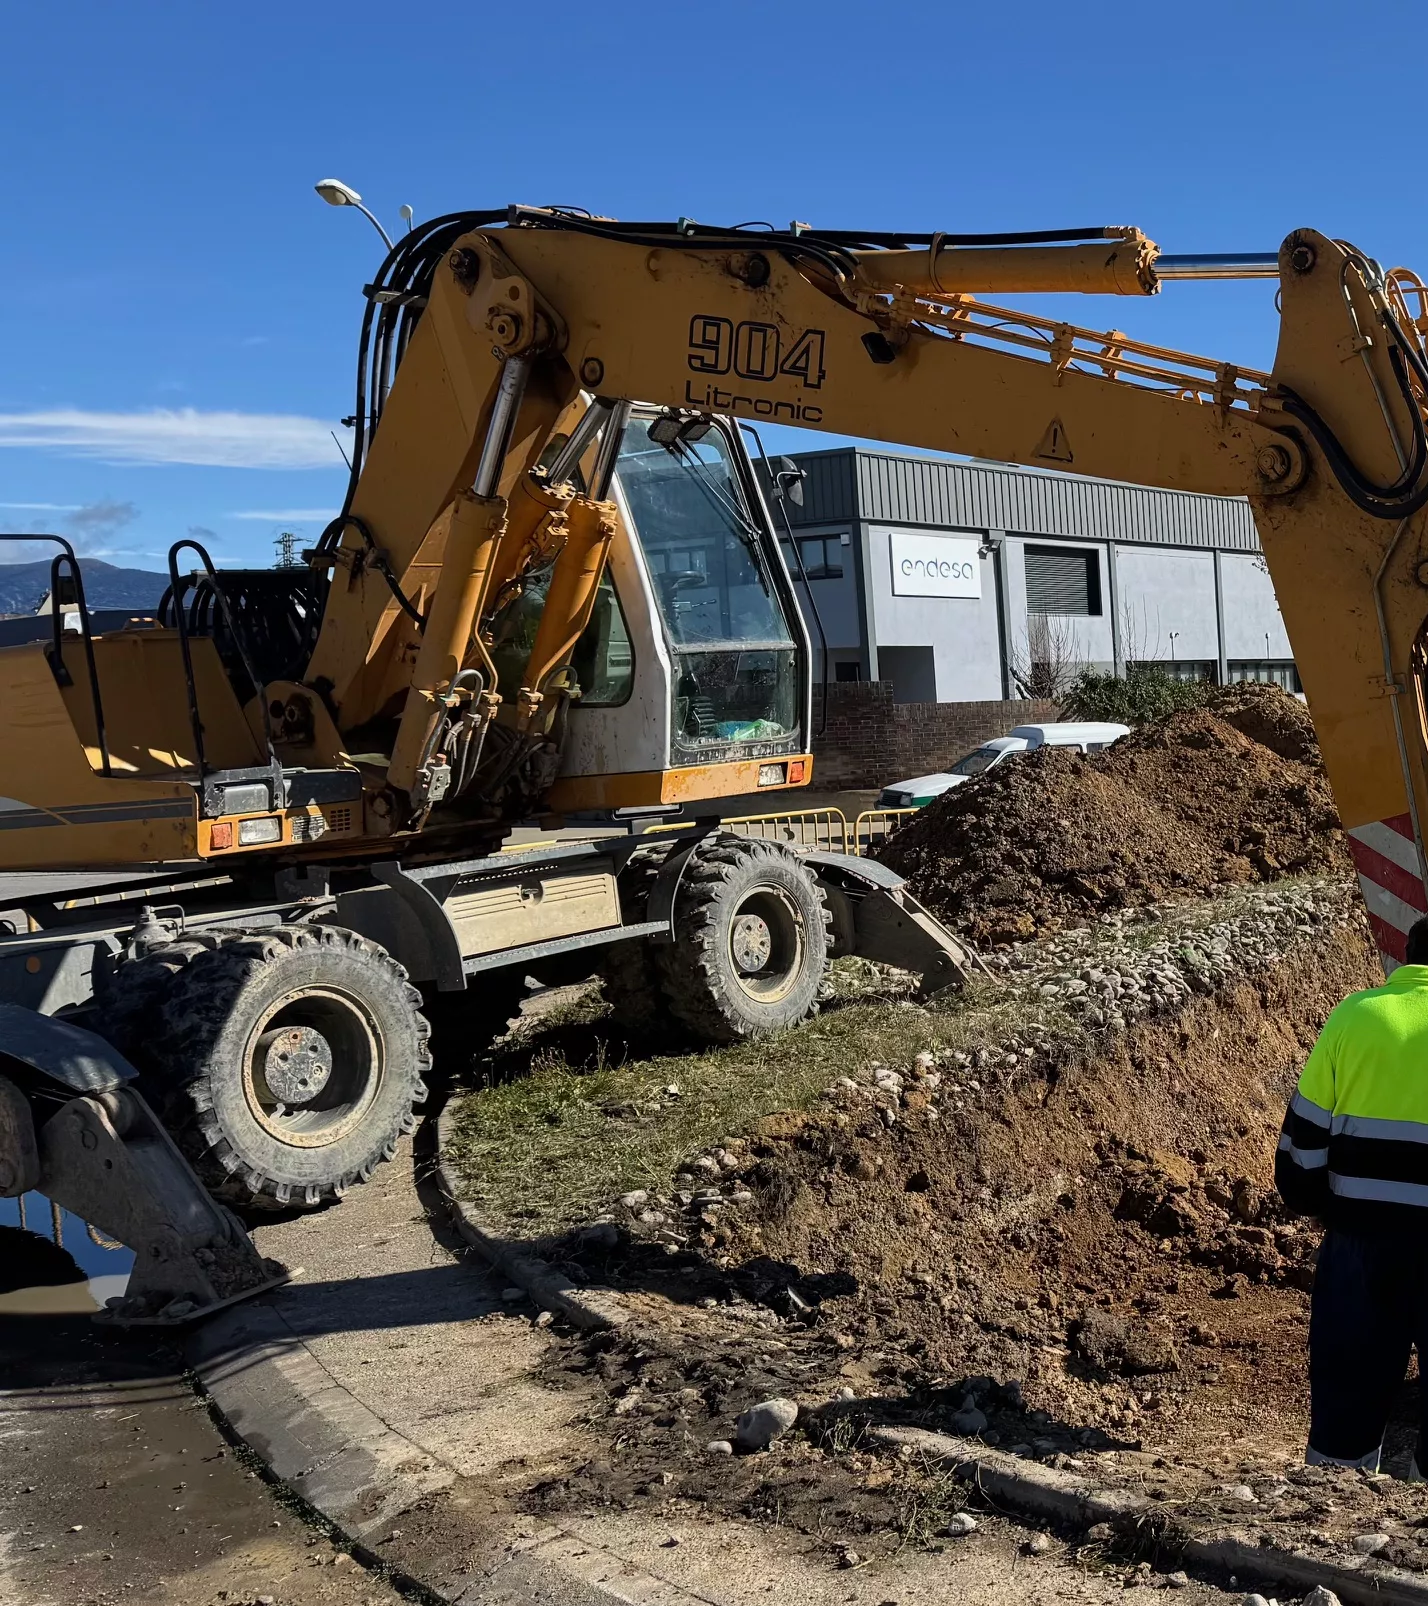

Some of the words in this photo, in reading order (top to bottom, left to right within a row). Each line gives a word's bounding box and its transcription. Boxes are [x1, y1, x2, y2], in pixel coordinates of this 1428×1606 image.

[686, 314, 826, 390] 904
[685, 379, 824, 423] Litronic
[900, 556, 974, 581] endesa
